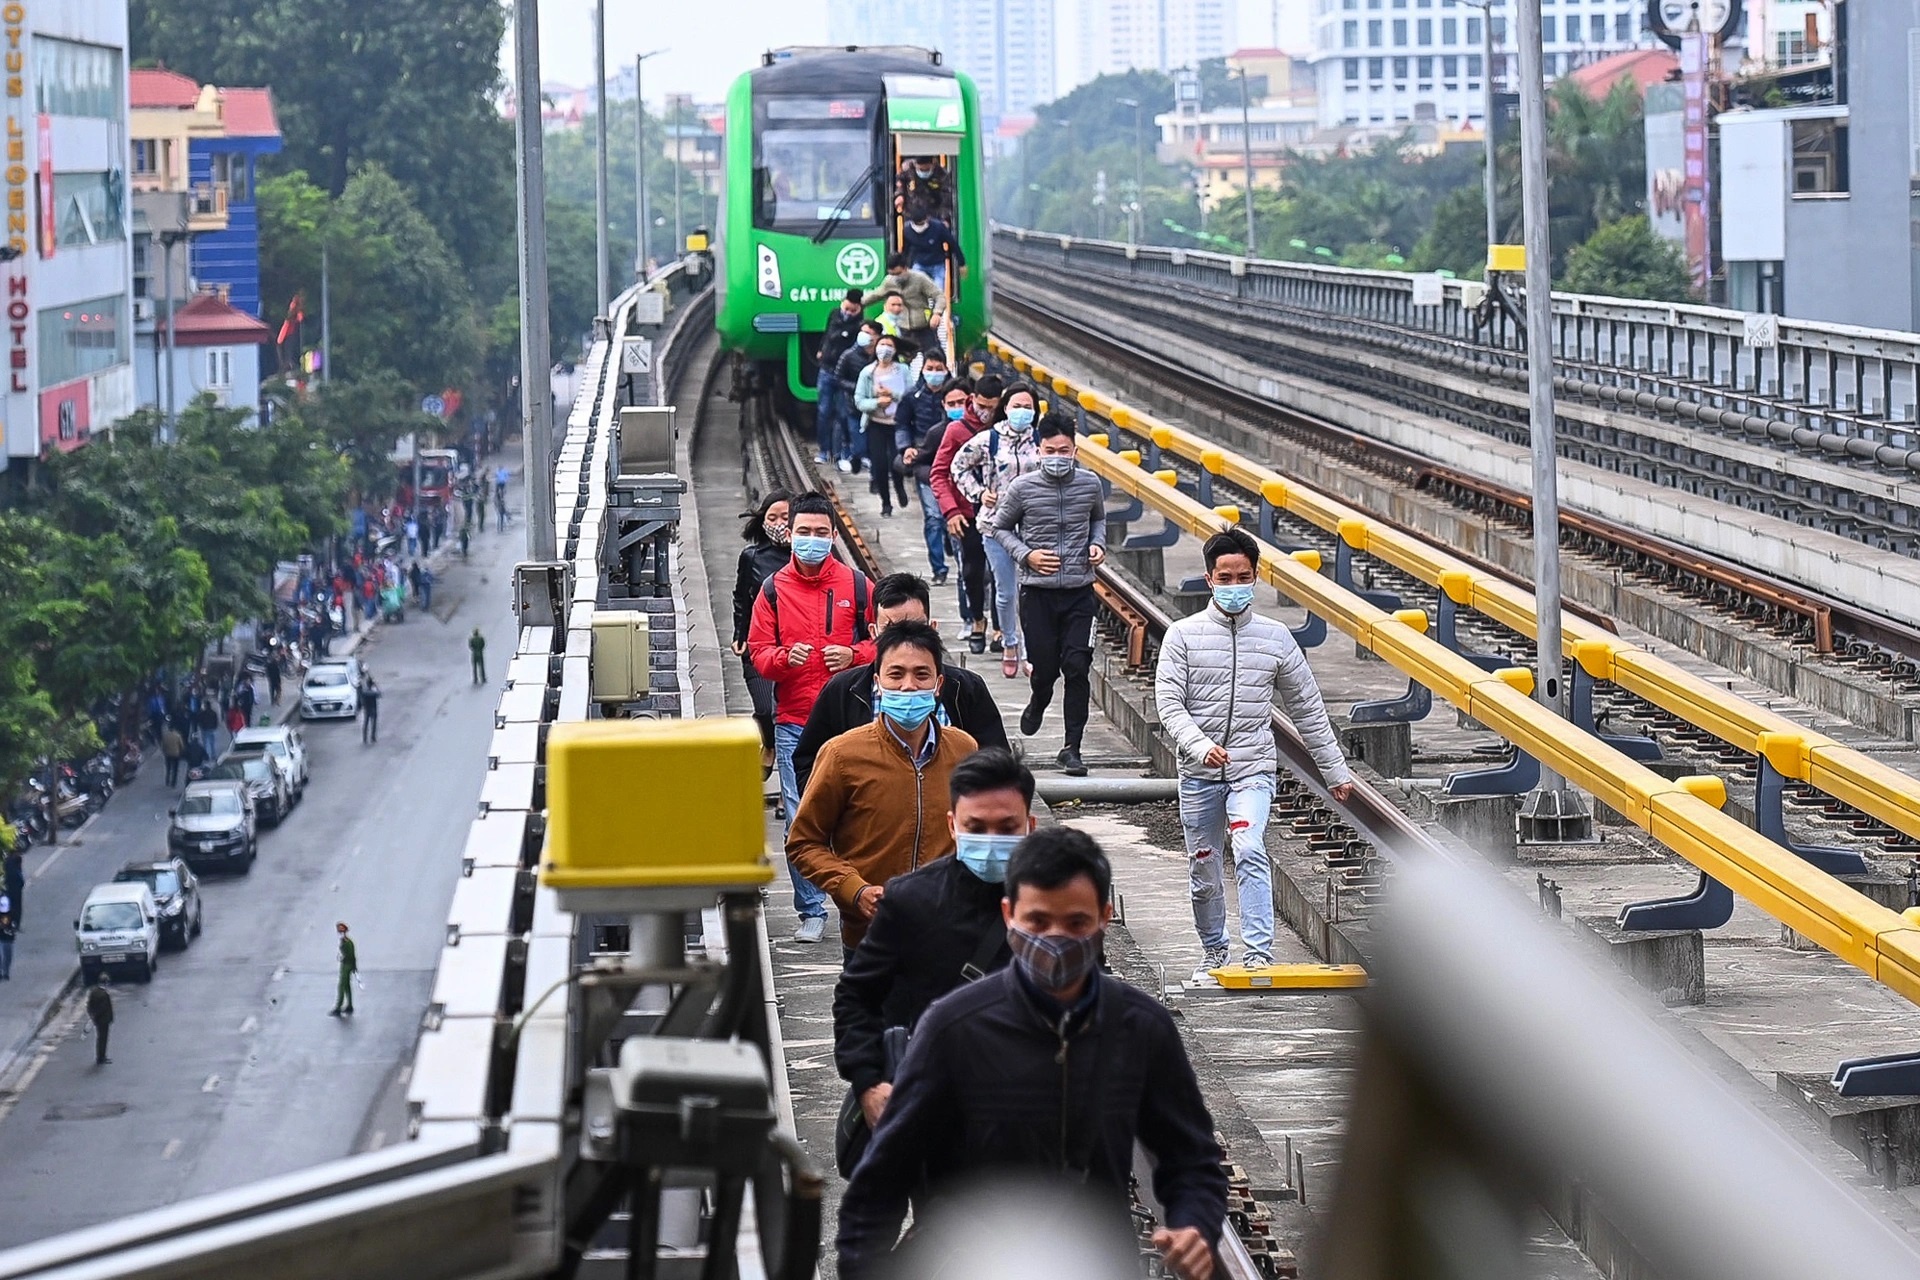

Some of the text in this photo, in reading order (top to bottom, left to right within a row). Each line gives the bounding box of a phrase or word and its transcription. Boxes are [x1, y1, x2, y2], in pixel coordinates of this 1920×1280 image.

[2, 0, 25, 98] OTUS
[8, 276, 28, 393] HOTEL
[790, 285, 818, 302] CÁT
